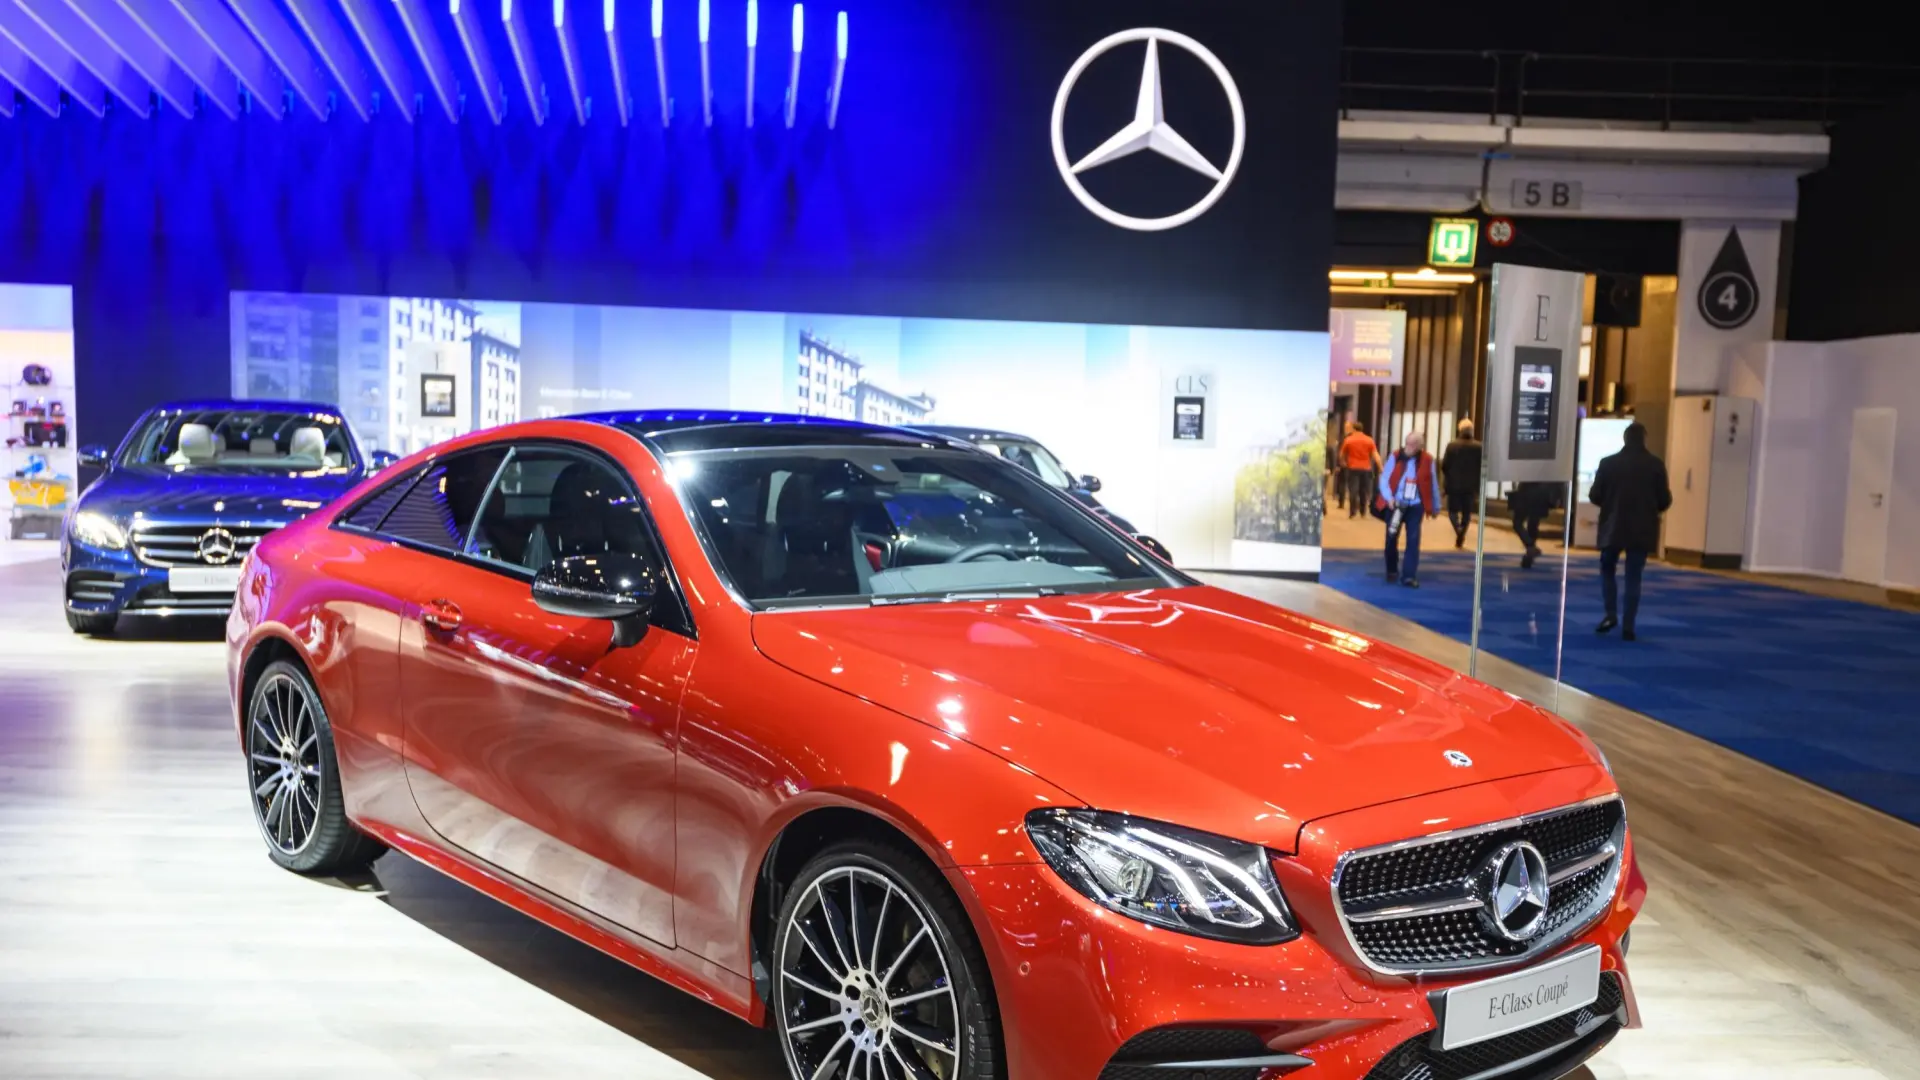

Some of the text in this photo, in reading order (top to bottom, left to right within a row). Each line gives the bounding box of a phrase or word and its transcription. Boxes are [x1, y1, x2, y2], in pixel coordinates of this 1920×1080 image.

[1524, 181, 1569, 206] 5 B
[1718, 283, 1738, 311] 4
[1534, 294, 1550, 342] E
[1488, 975, 1569, 1020] E-Class Coupé
